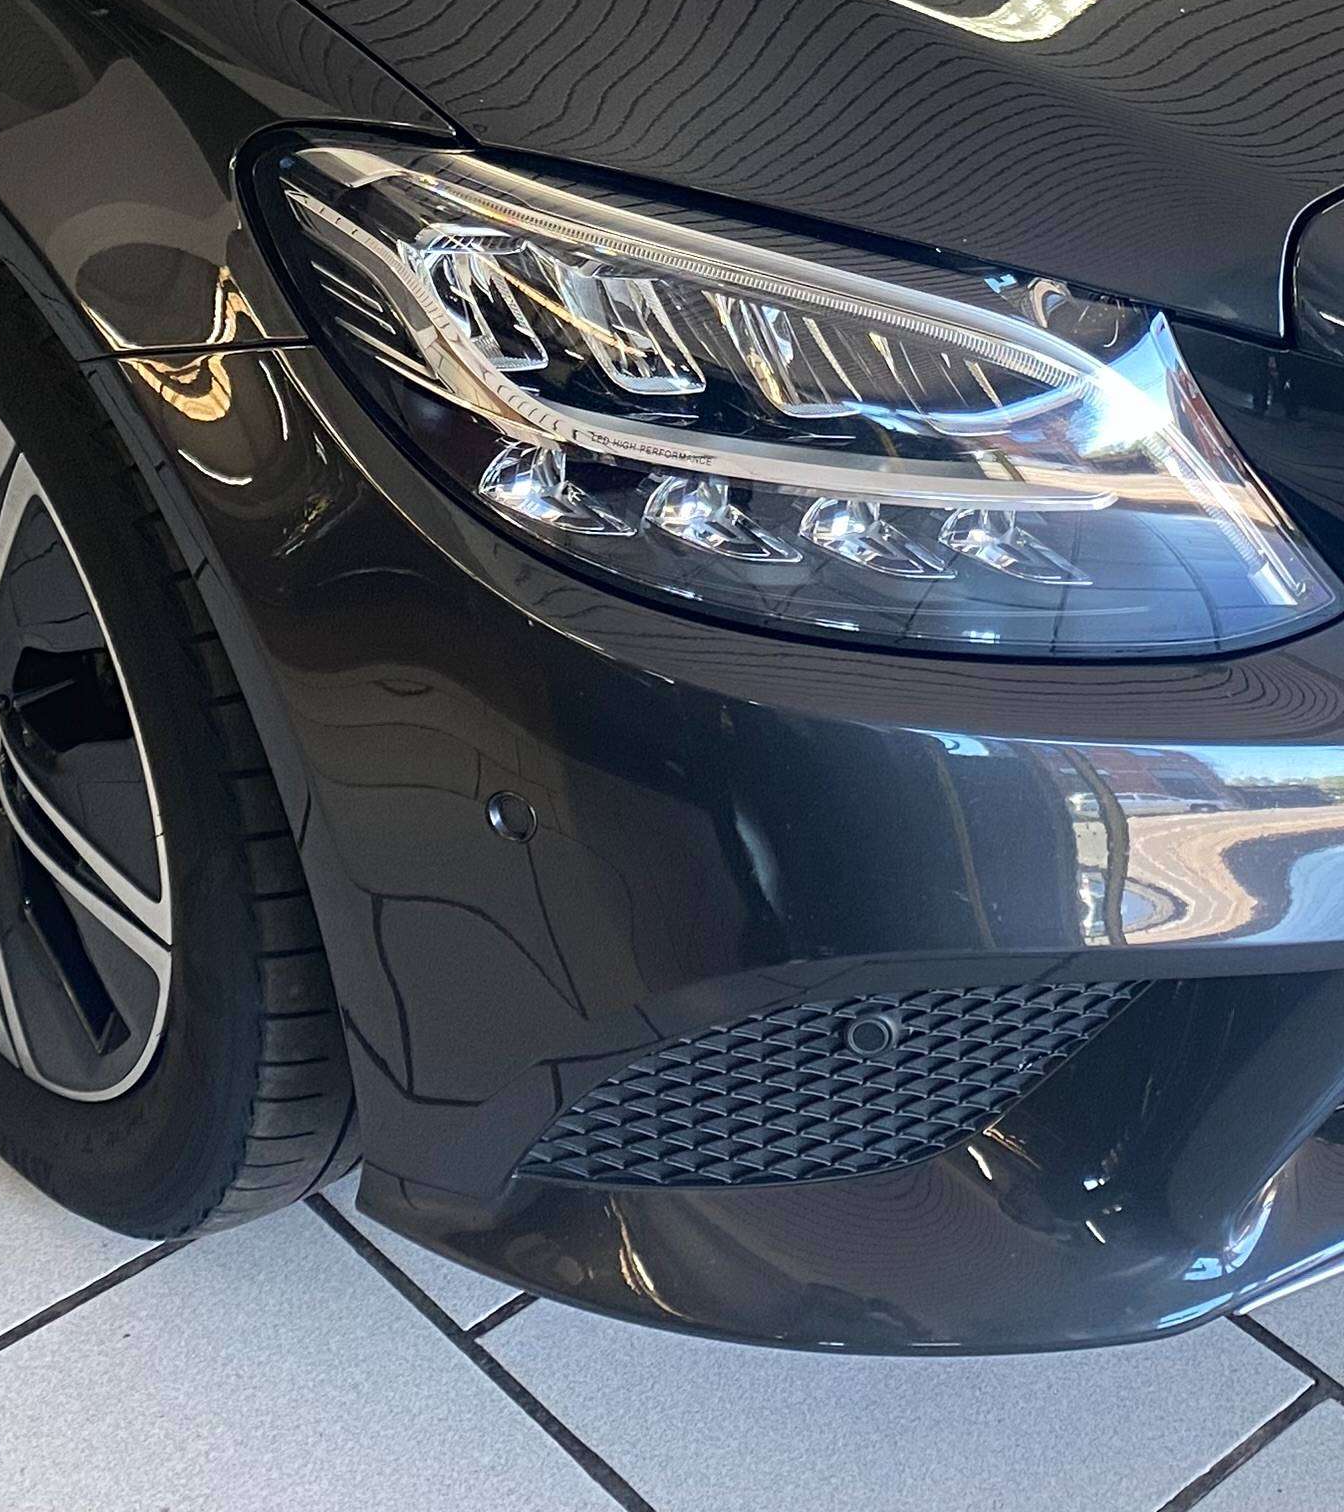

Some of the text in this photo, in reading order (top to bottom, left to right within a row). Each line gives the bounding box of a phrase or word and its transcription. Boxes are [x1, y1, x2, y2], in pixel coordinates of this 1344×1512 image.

[591, 432, 713, 467] LED HIGH PERFORMANCE
